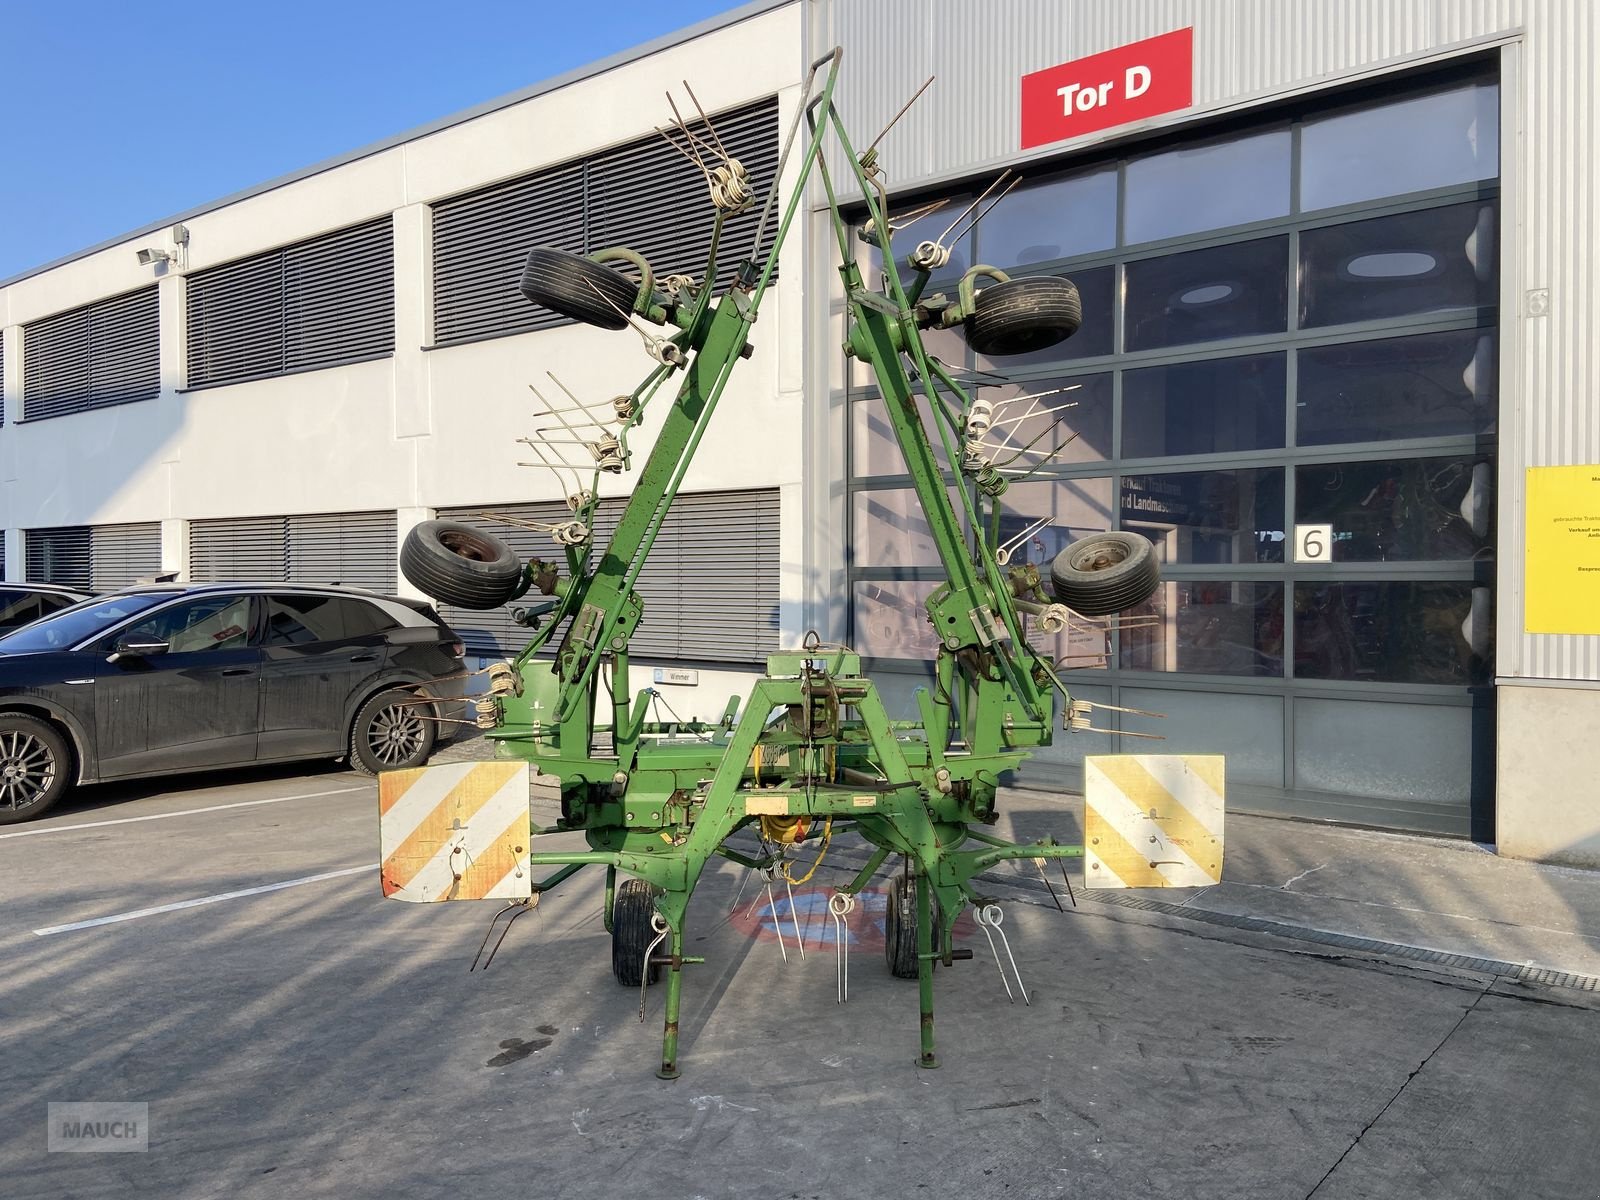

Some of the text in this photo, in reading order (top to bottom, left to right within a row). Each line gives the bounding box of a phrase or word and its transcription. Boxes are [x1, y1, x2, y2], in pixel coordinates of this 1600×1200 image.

[1056, 65, 1152, 117] Tor D
[1303, 529, 1323, 558] 6
